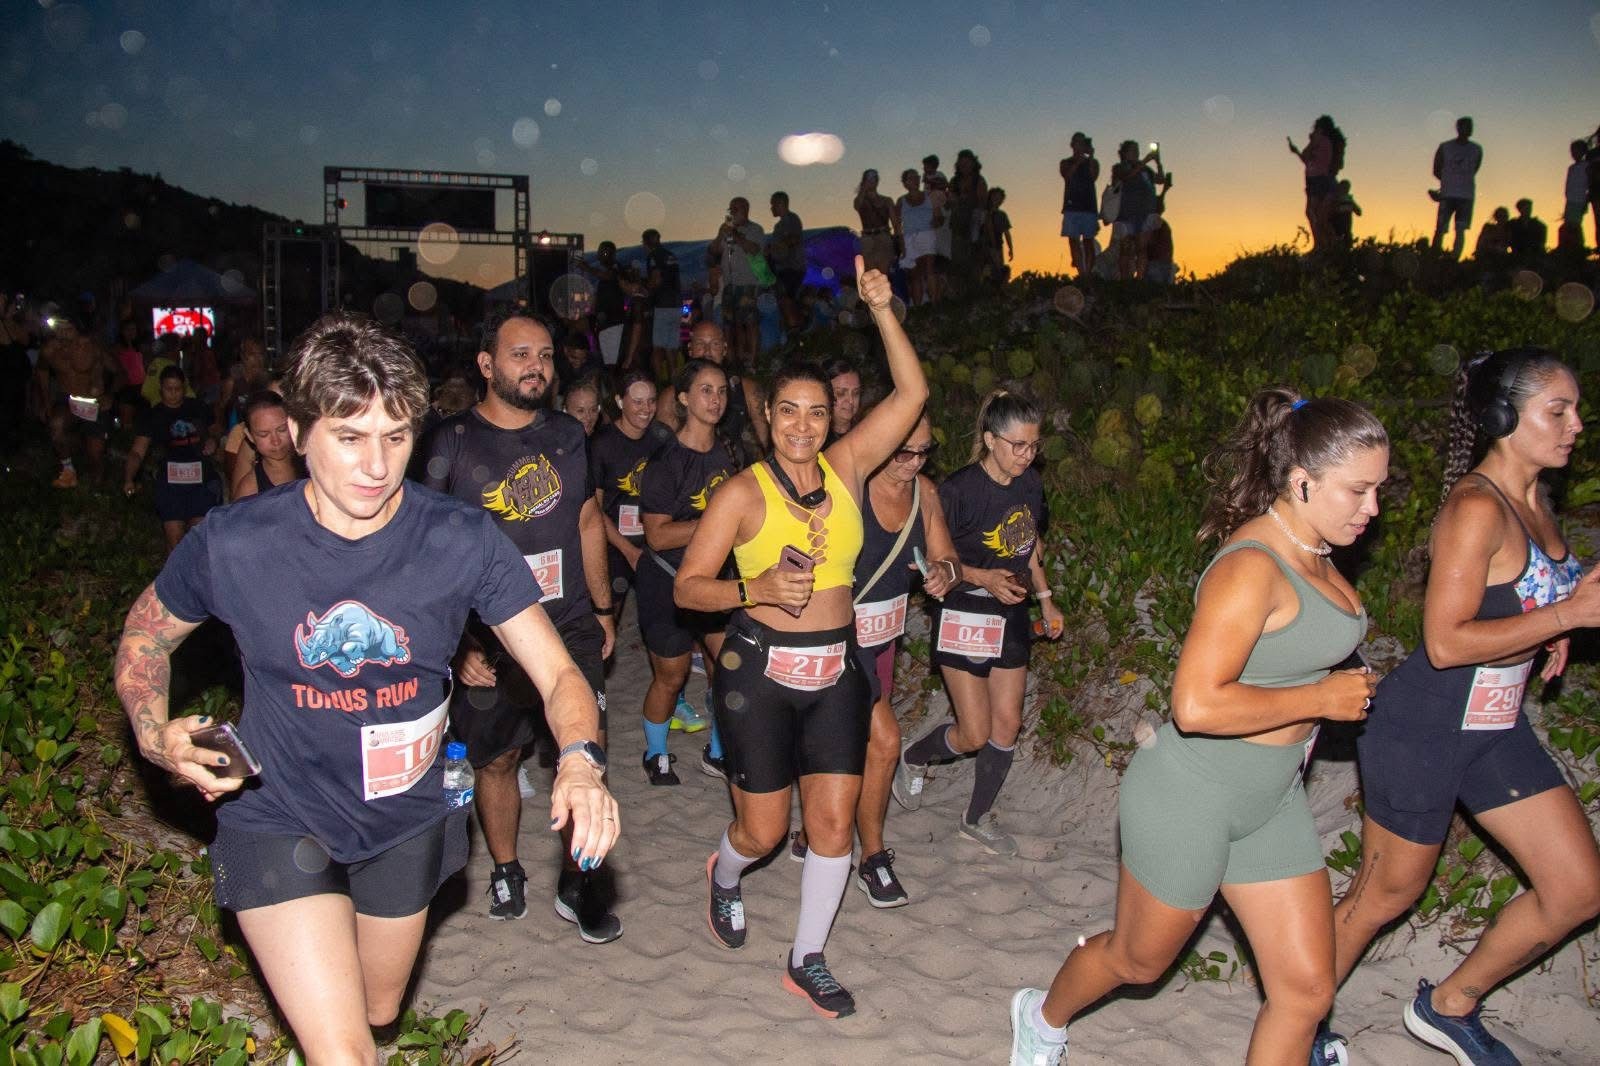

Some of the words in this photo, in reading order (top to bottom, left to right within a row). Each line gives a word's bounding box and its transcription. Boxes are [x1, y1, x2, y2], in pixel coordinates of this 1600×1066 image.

[506, 455, 536, 480] SUMMER
[860, 612, 896, 634] 301
[958, 626, 985, 643] 04
[791, 655, 825, 677] 21
[292, 684, 368, 712] TONUS
[376, 677, 419, 708] RUN
